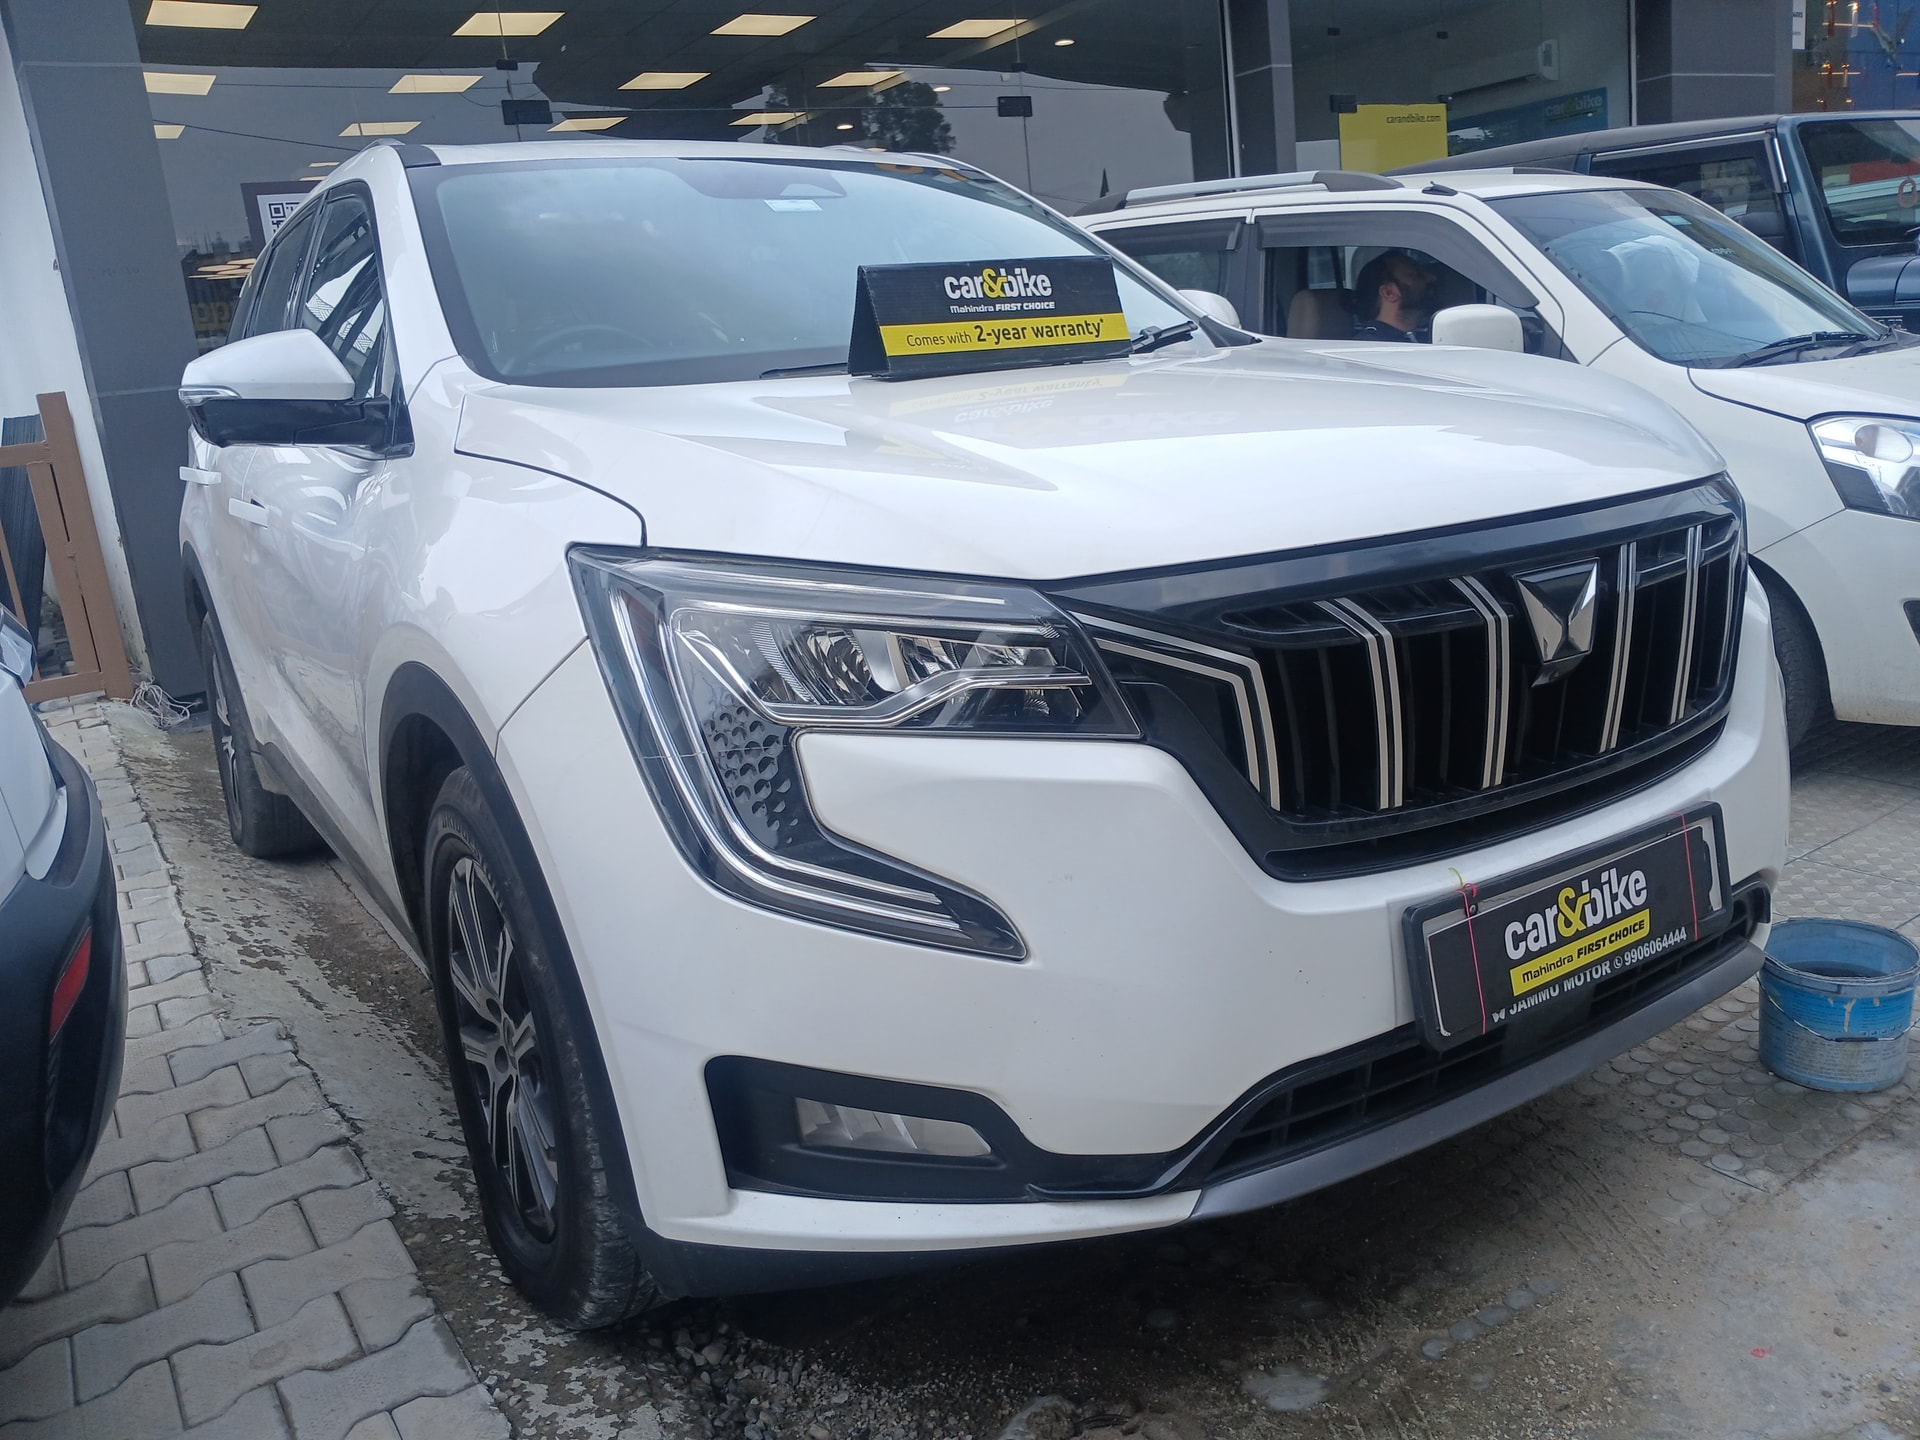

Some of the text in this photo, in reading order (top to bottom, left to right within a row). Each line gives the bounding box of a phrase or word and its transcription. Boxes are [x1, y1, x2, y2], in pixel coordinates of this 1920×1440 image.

[1386, 113, 1442, 124] carandbike.com
[943, 267, 1052, 300] car&bike
[950, 301, 1055, 314] Mahindra FIRST CHOICE
[906, 333, 945, 347] Comes
[946, 330, 972, 345] with
[973, 324, 1027, 345] 2-year
[1504, 868, 1648, 960] car&bike
[1521, 919, 1645, 984] Mahindra FIRST CHOICE
[1509, 926, 1687, 1016] JAMMU MOTOR 9906064444
